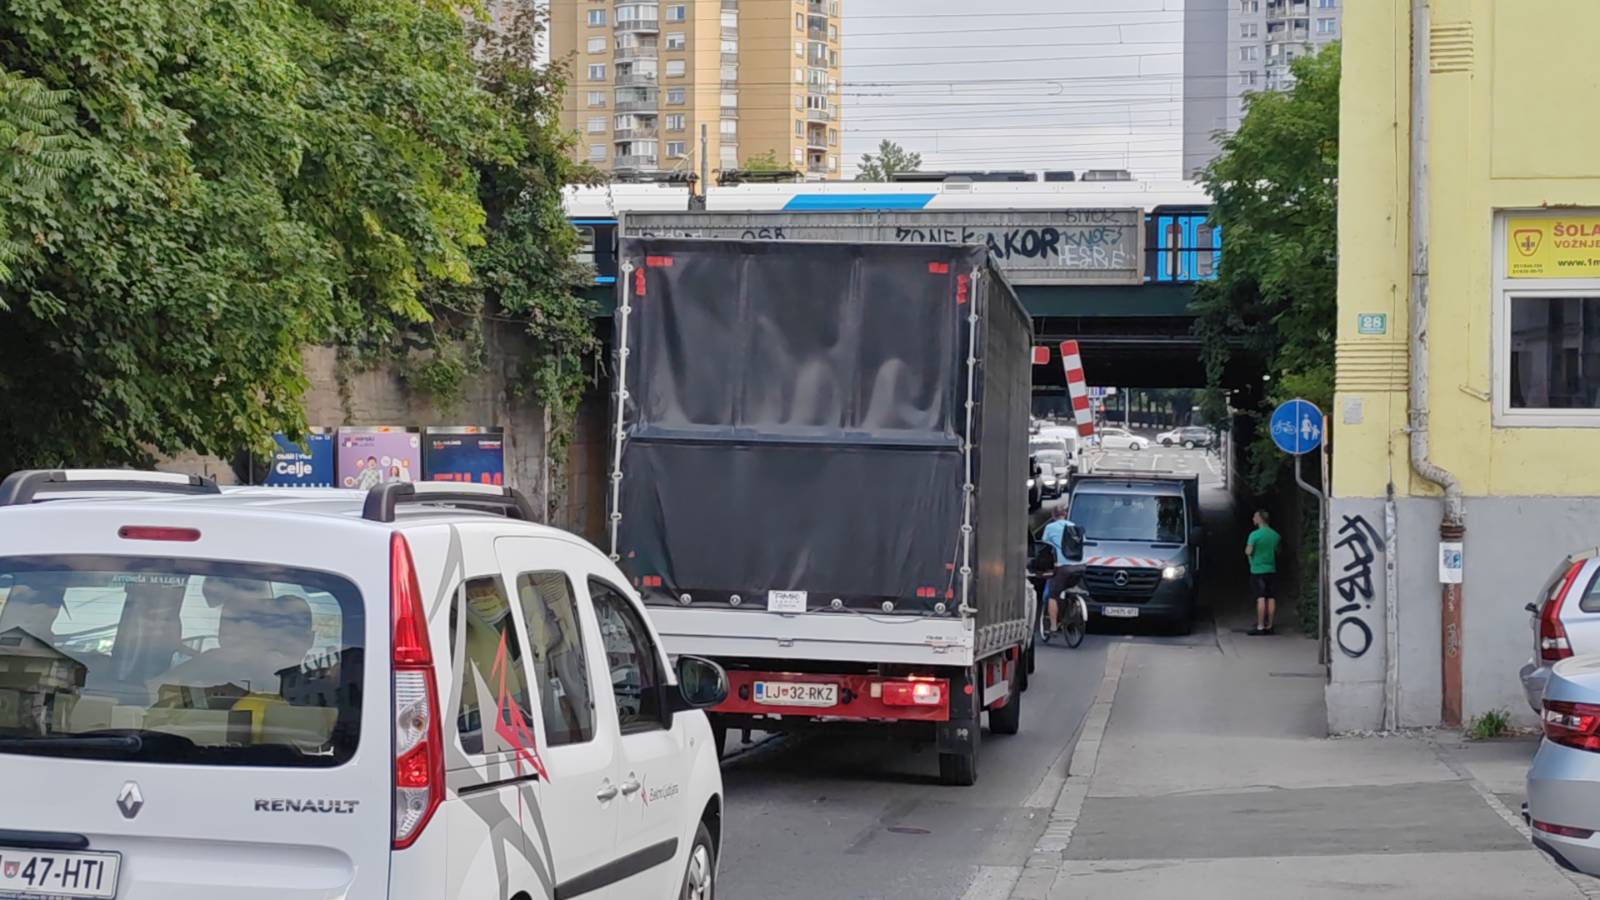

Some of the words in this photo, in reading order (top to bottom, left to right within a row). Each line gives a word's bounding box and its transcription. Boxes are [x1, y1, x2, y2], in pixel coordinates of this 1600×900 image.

[1363, 316, 1382, 329] 28
[276, 461, 313, 478] Celje
[765, 685, 781, 699] LJ
[790, 686, 833, 701] 32-RKZ
[253, 799, 360, 814] RENAULT
[21, 856, 104, 890] 47-HTI
